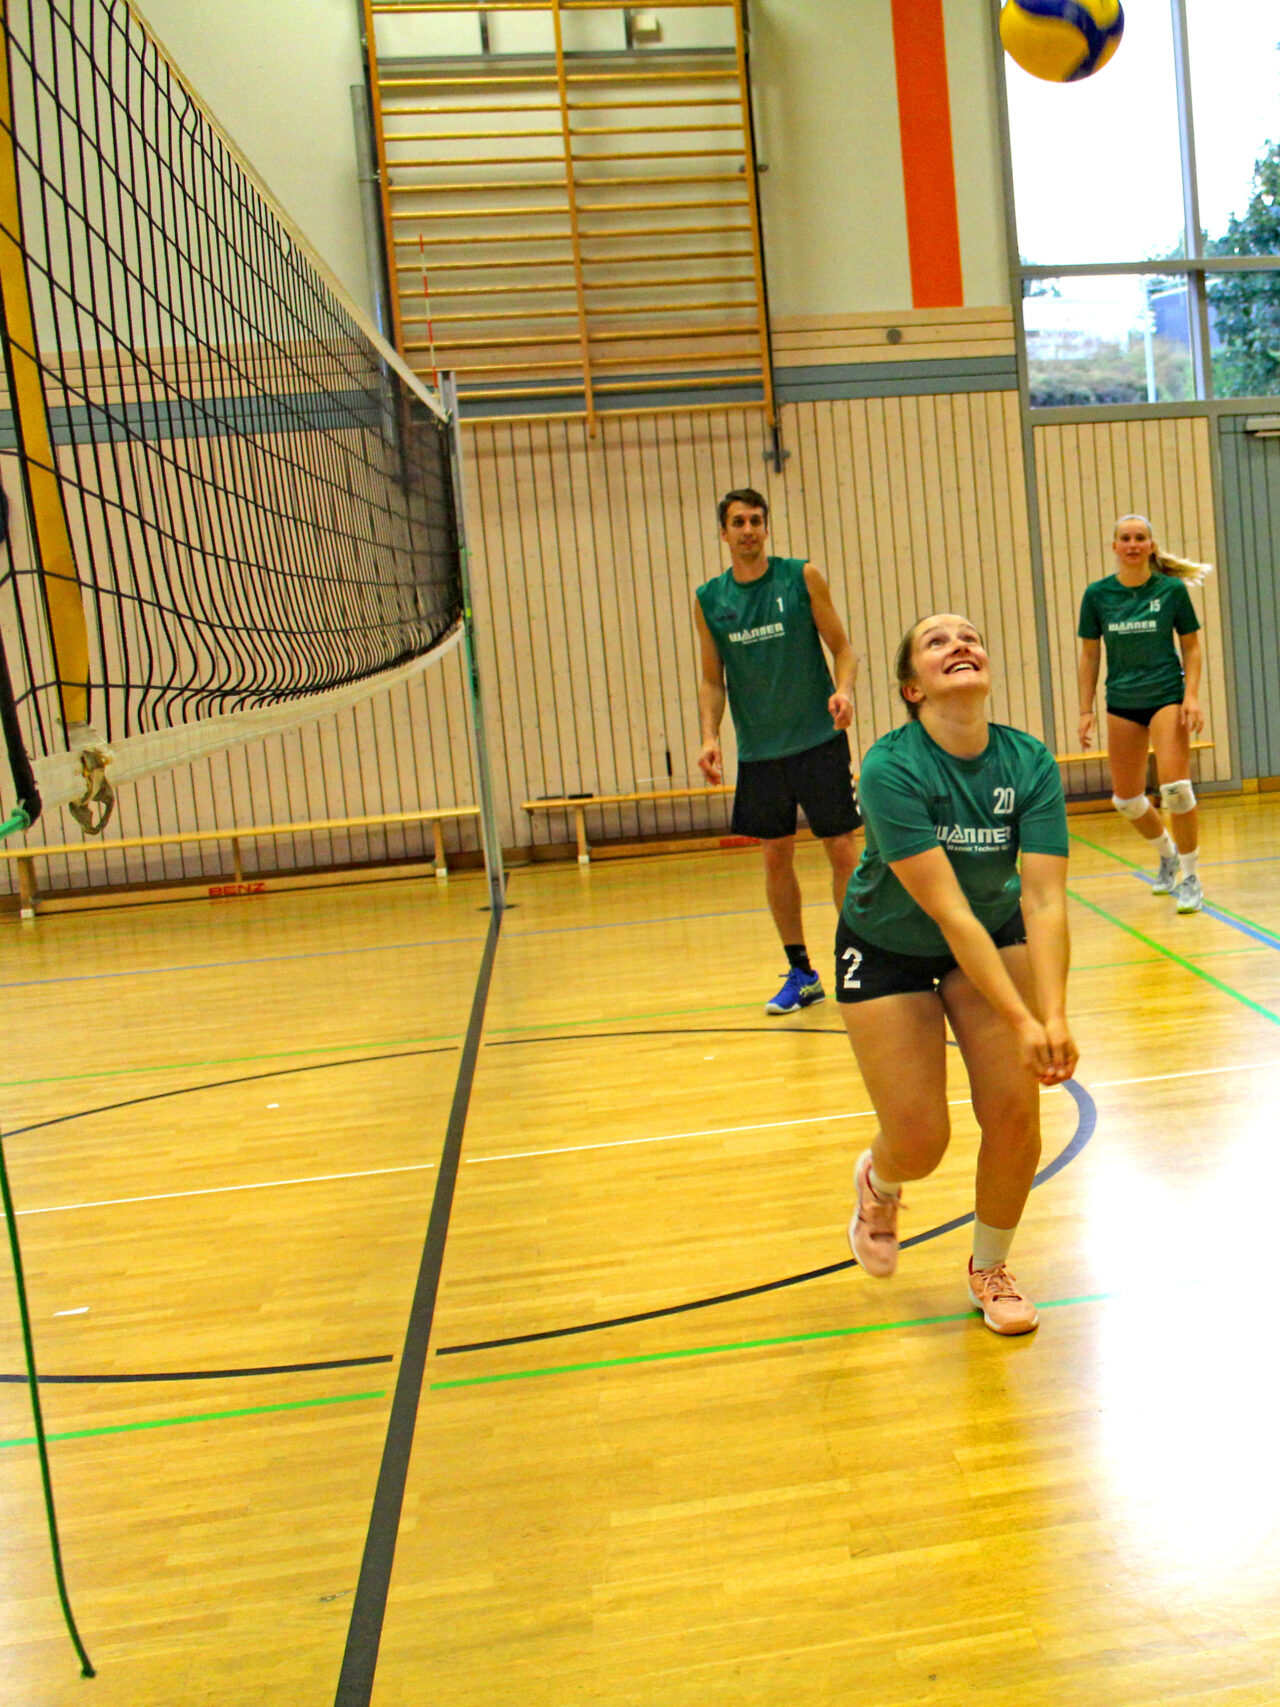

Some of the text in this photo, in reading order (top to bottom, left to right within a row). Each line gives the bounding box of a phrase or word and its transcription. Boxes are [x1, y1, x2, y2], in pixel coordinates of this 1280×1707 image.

[776, 597, 784, 613] 1
[993, 787, 1015, 814] 20
[208, 882, 265, 896] BENZ
[842, 947, 863, 989] 2
